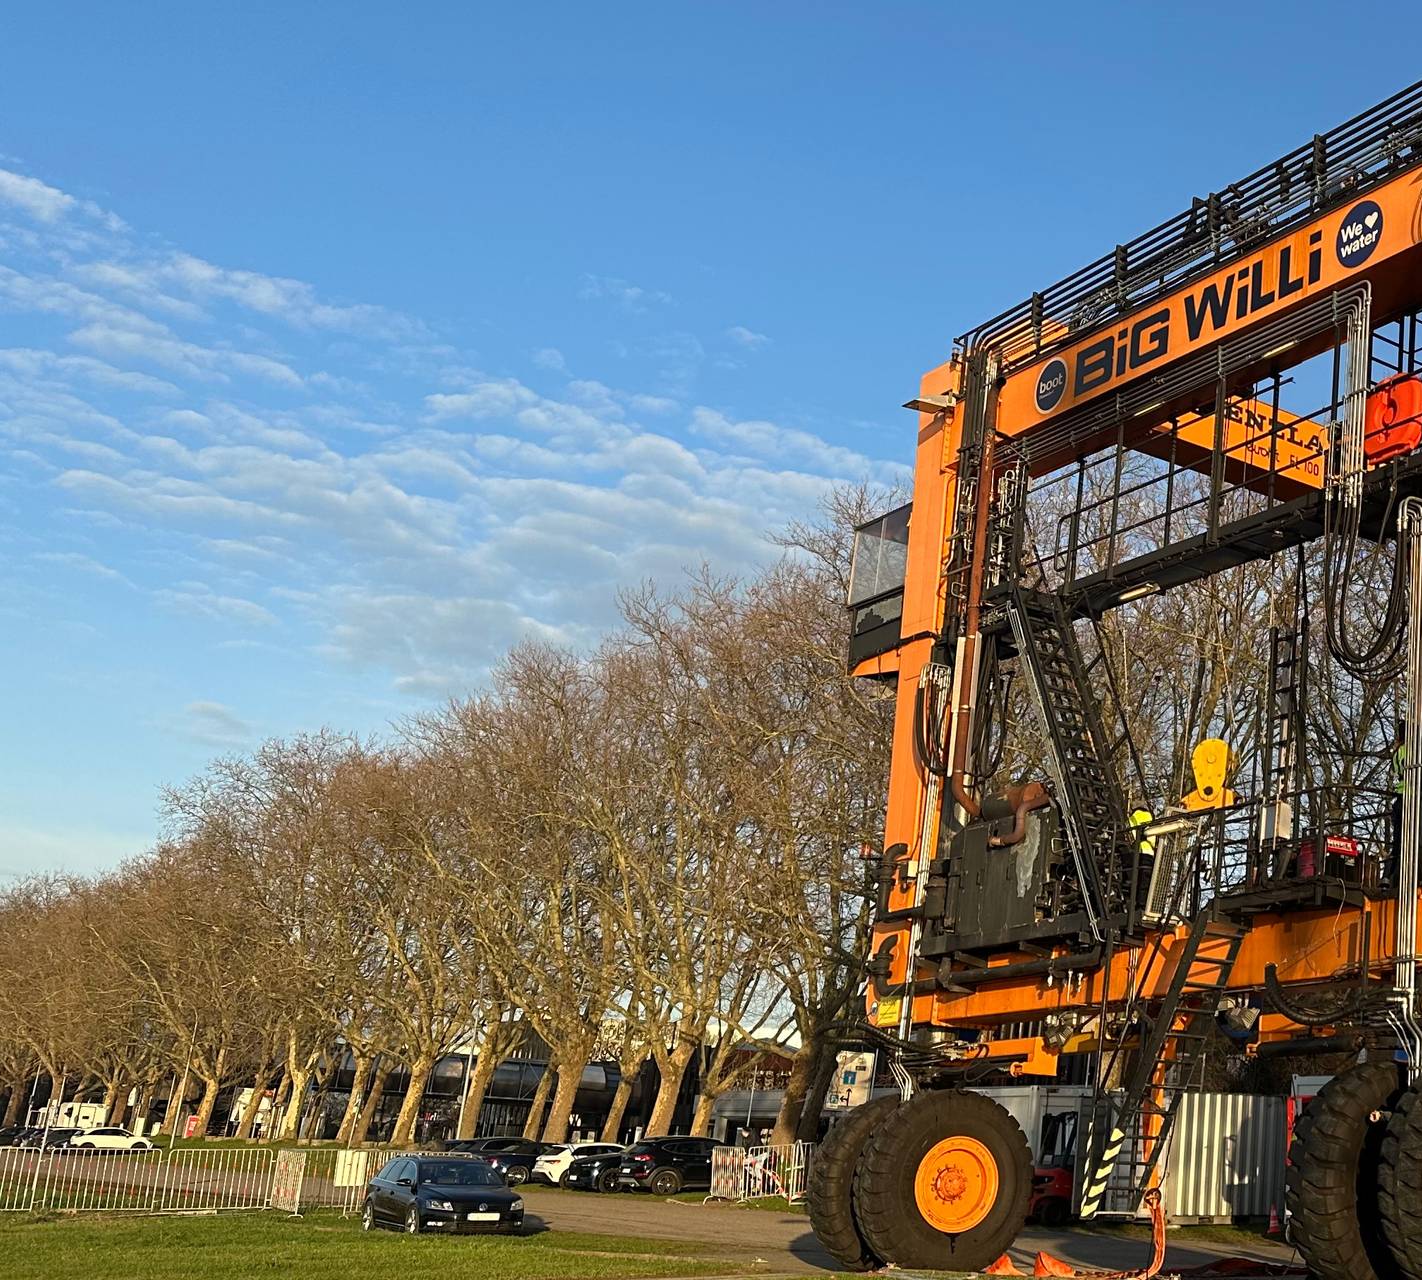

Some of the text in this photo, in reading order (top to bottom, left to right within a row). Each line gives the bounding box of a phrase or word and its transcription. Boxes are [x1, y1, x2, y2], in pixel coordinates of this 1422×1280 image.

[1341, 222, 1363, 243] We
[1341, 229, 1378, 258] water
[1039, 373, 1063, 394] boot
